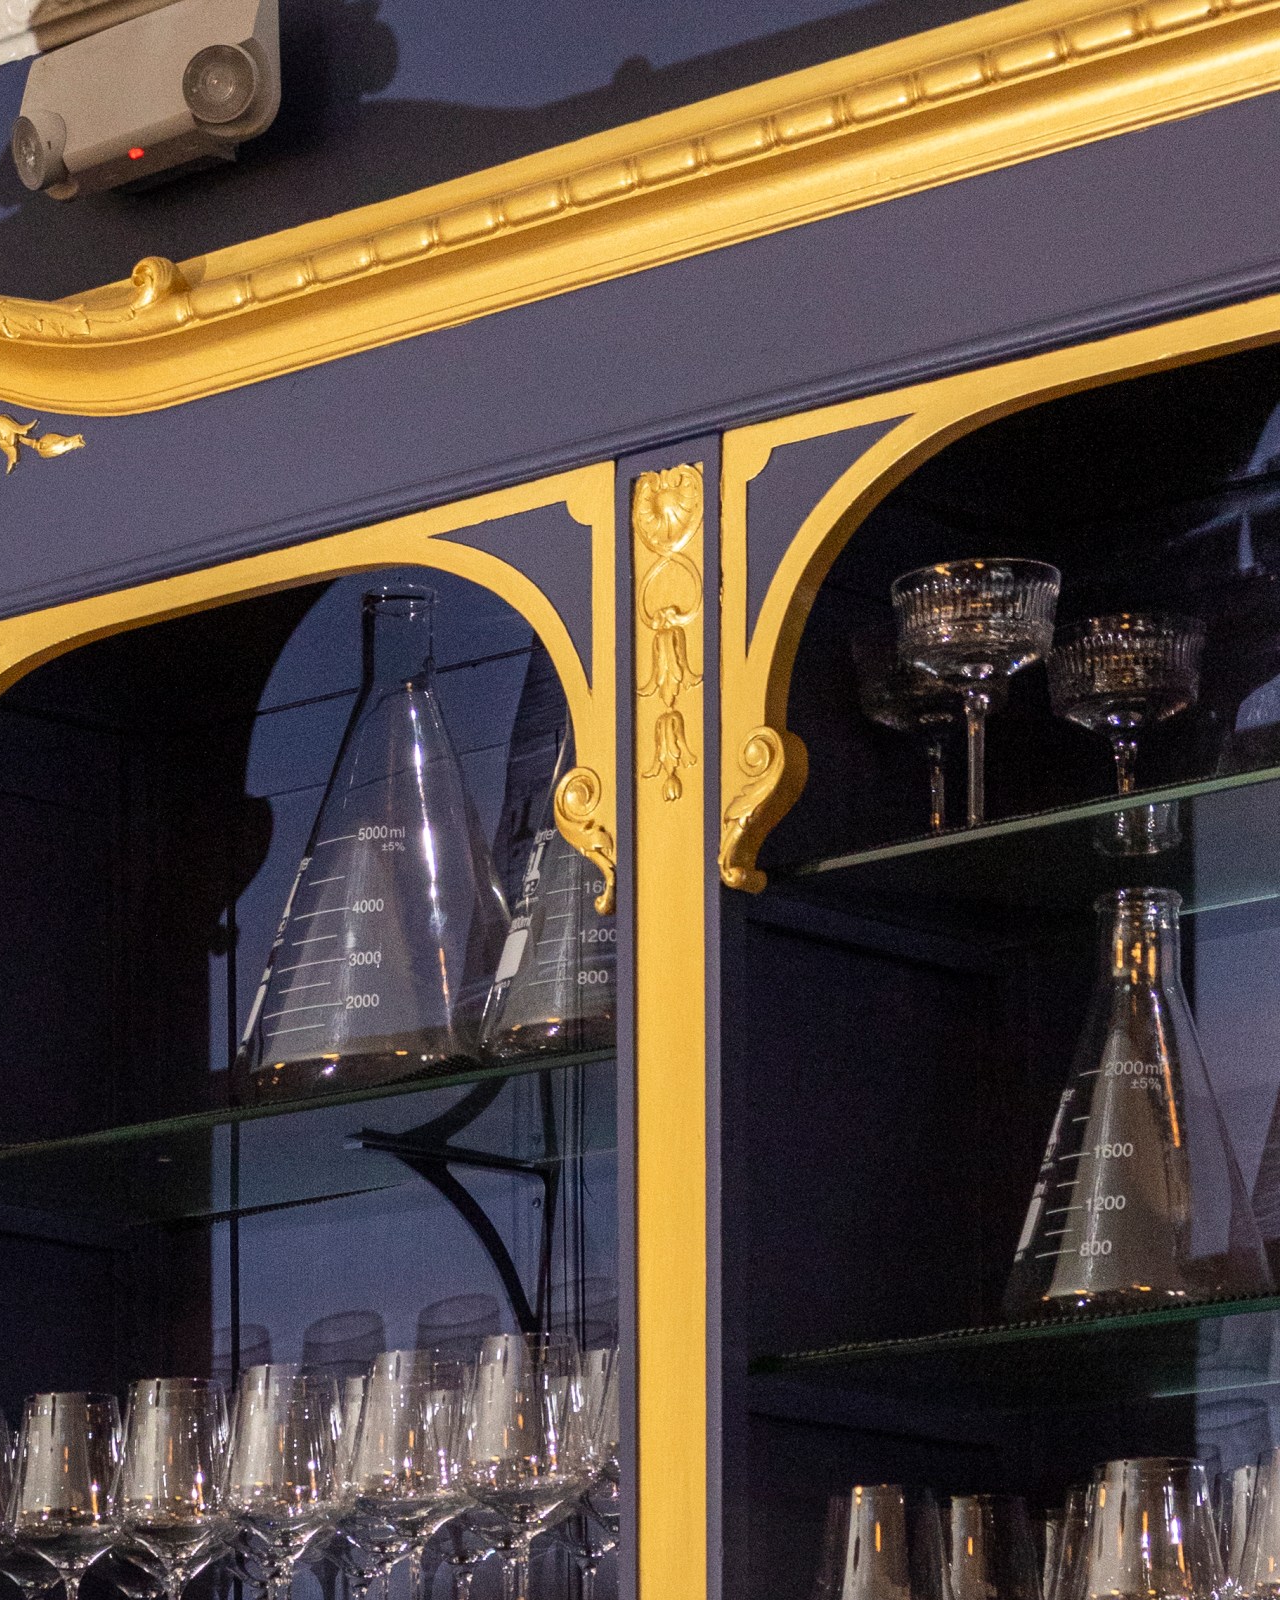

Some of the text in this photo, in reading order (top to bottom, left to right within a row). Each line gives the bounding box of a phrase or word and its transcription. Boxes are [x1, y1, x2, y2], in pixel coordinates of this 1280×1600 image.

[358, 826, 388, 841] 5000
[352, 899, 384, 914] 4000
[349, 951, 382, 967] 3000
[577, 970, 608, 985] 800
[346, 994, 379, 1010] 2000
[1093, 1142, 1134, 1158] 1600
[1086, 1195, 1126, 1211] 1200
[1080, 1240, 1112, 1257] 800
